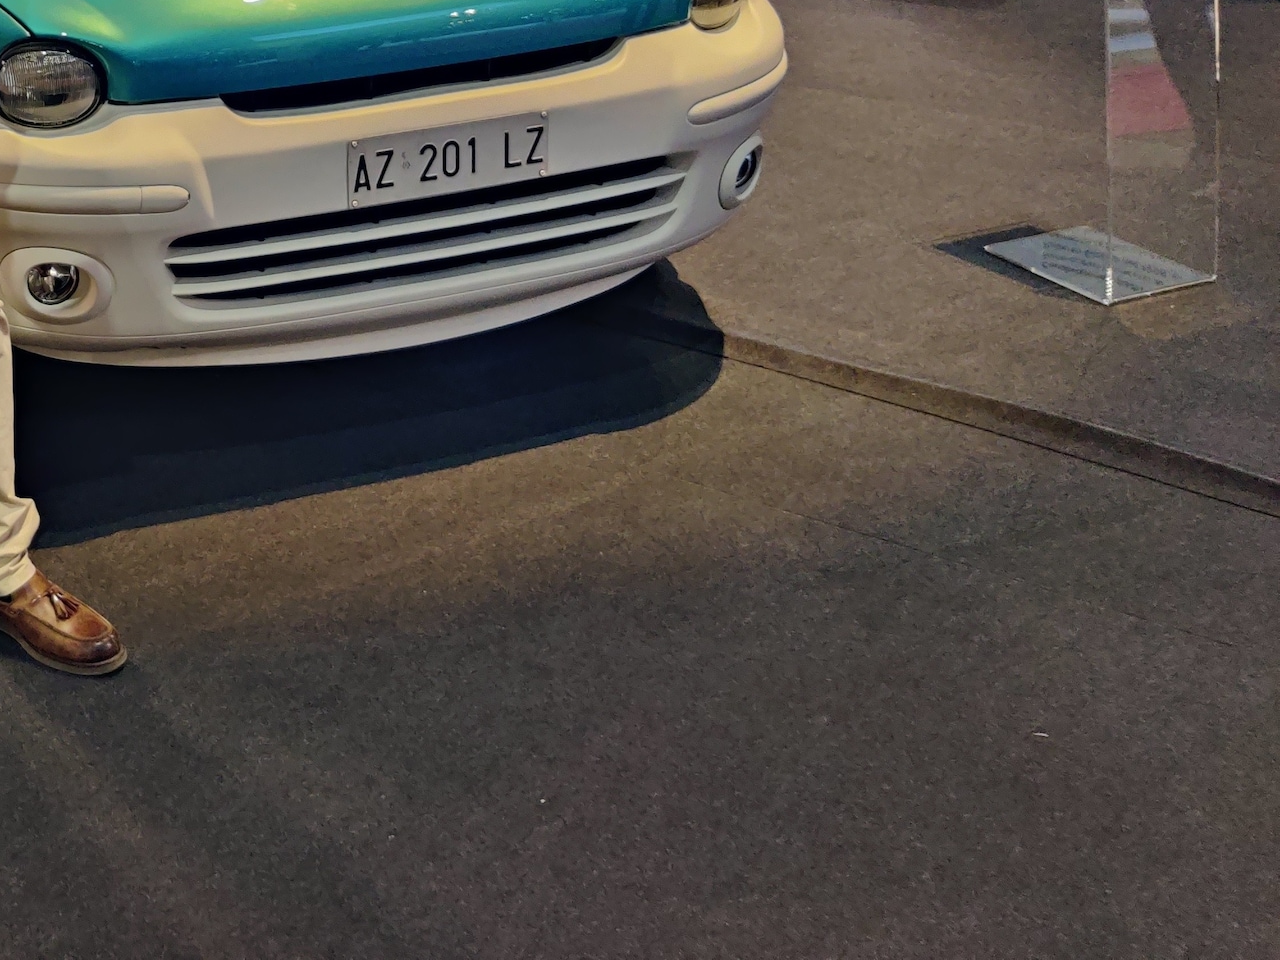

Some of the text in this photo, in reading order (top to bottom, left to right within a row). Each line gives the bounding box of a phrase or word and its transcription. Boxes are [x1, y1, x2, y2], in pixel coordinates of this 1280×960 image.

[353, 148, 395, 193] AZ
[419, 136, 477, 183] 201
[503, 125, 545, 169] LZ
